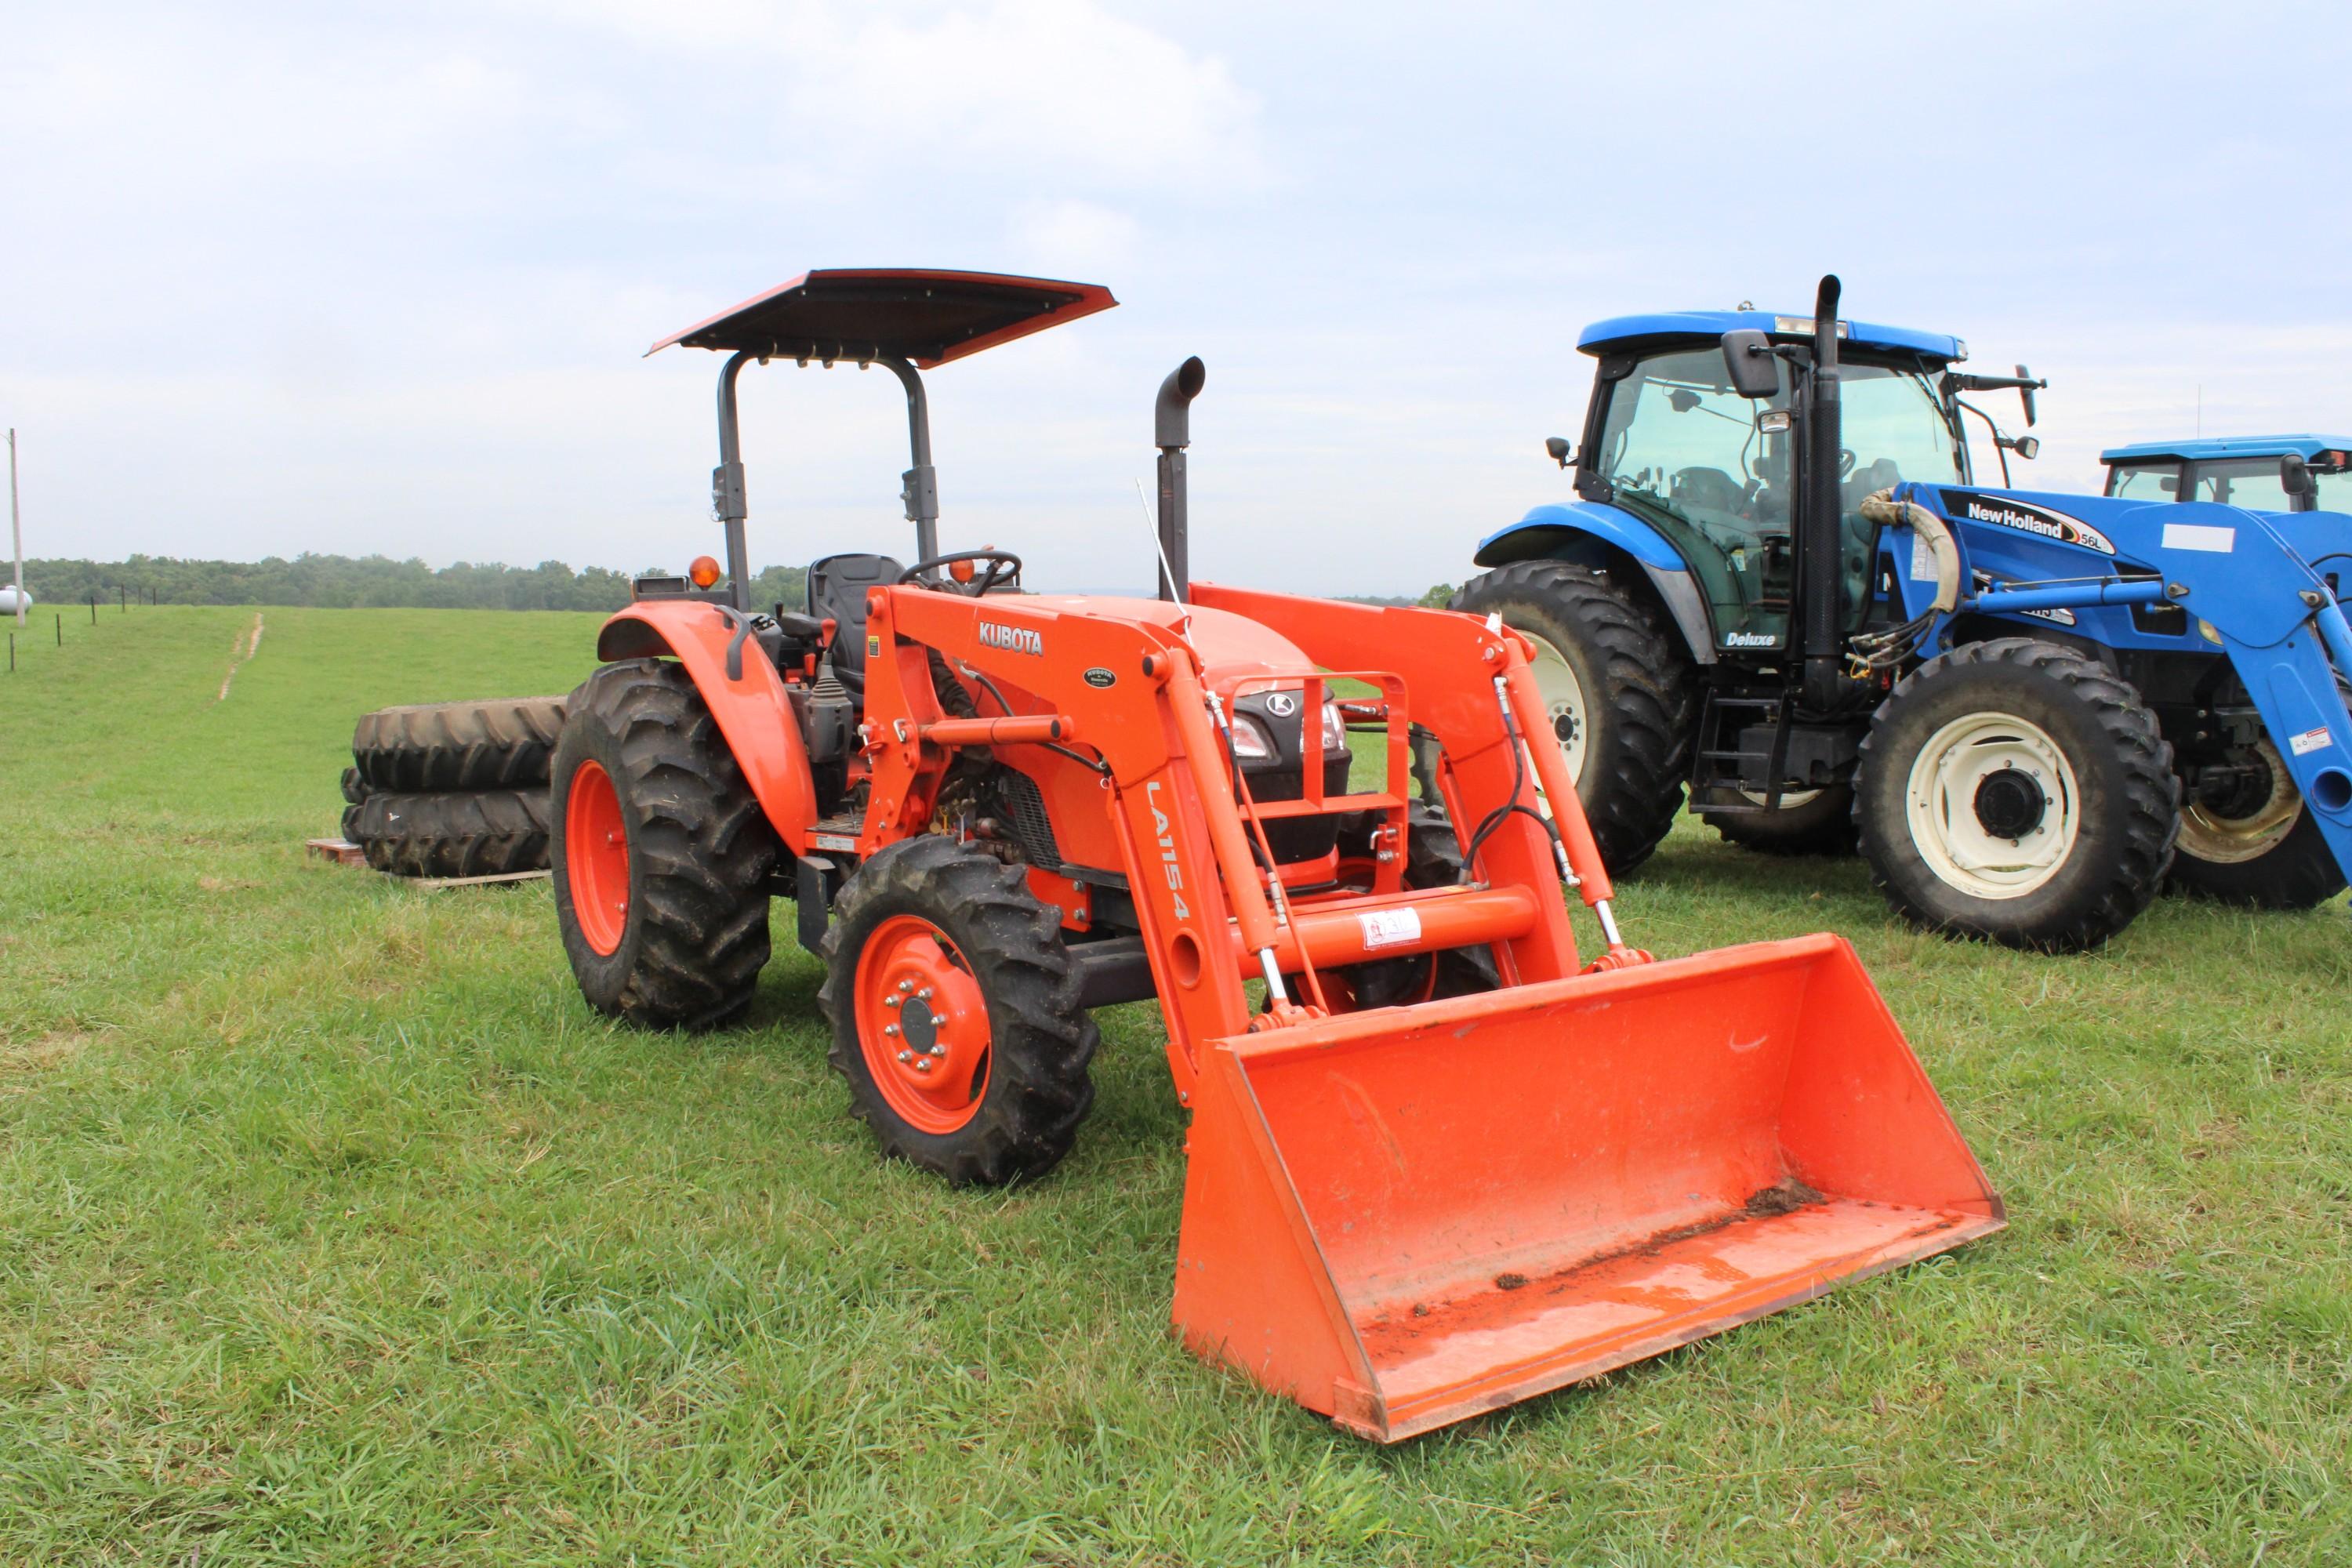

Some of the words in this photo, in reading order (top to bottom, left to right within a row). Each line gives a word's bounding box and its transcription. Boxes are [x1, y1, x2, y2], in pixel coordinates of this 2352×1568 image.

[1969, 503, 2002, 523] New
[2004, 510, 2062, 539] Holland
[979, 621, 1043, 656] KUBOTA
[1726, 632, 1776, 646] Deluxe
[1147, 782, 1190, 920] LA1154
